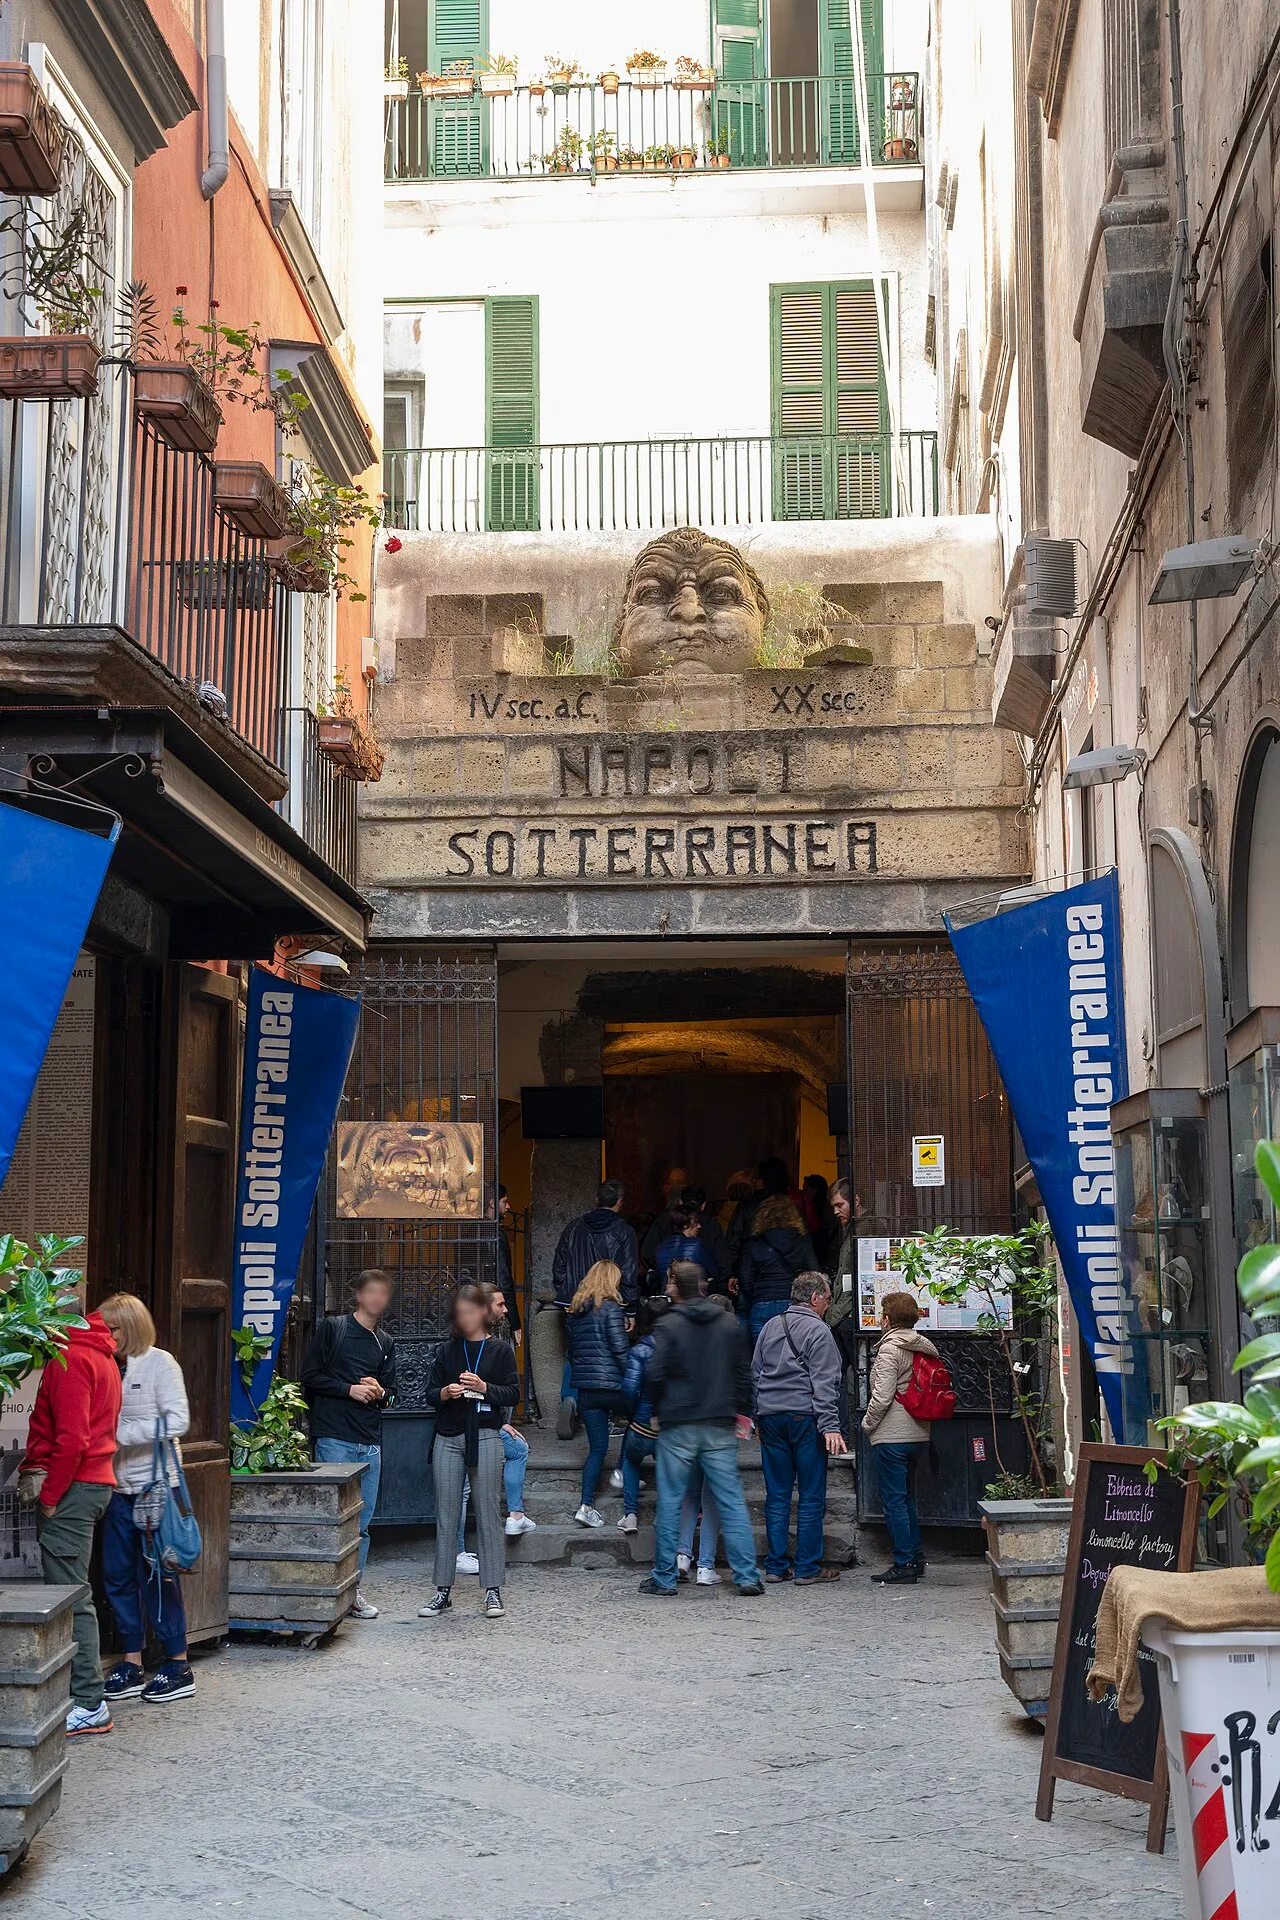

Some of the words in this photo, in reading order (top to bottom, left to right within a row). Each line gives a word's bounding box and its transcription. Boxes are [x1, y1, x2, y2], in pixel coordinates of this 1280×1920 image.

[769, 684, 816, 715] XX
[820, 691, 864, 713] sec.
[557, 743, 792, 797] NAPOLI
[445, 822, 879, 878] SOTTERRANEA
[1066, 903, 1117, 1205] Sotterranea
[242, 991, 294, 1228] Sotterranea
[1076, 1224, 1135, 1375] Napoli
[1104, 1500, 1154, 1522] Limoncello
[1106, 1474, 1142, 1496] Fabbrica
[1086, 1528, 1138, 1550] limoncello
[1138, 1534, 1176, 1567] factory
